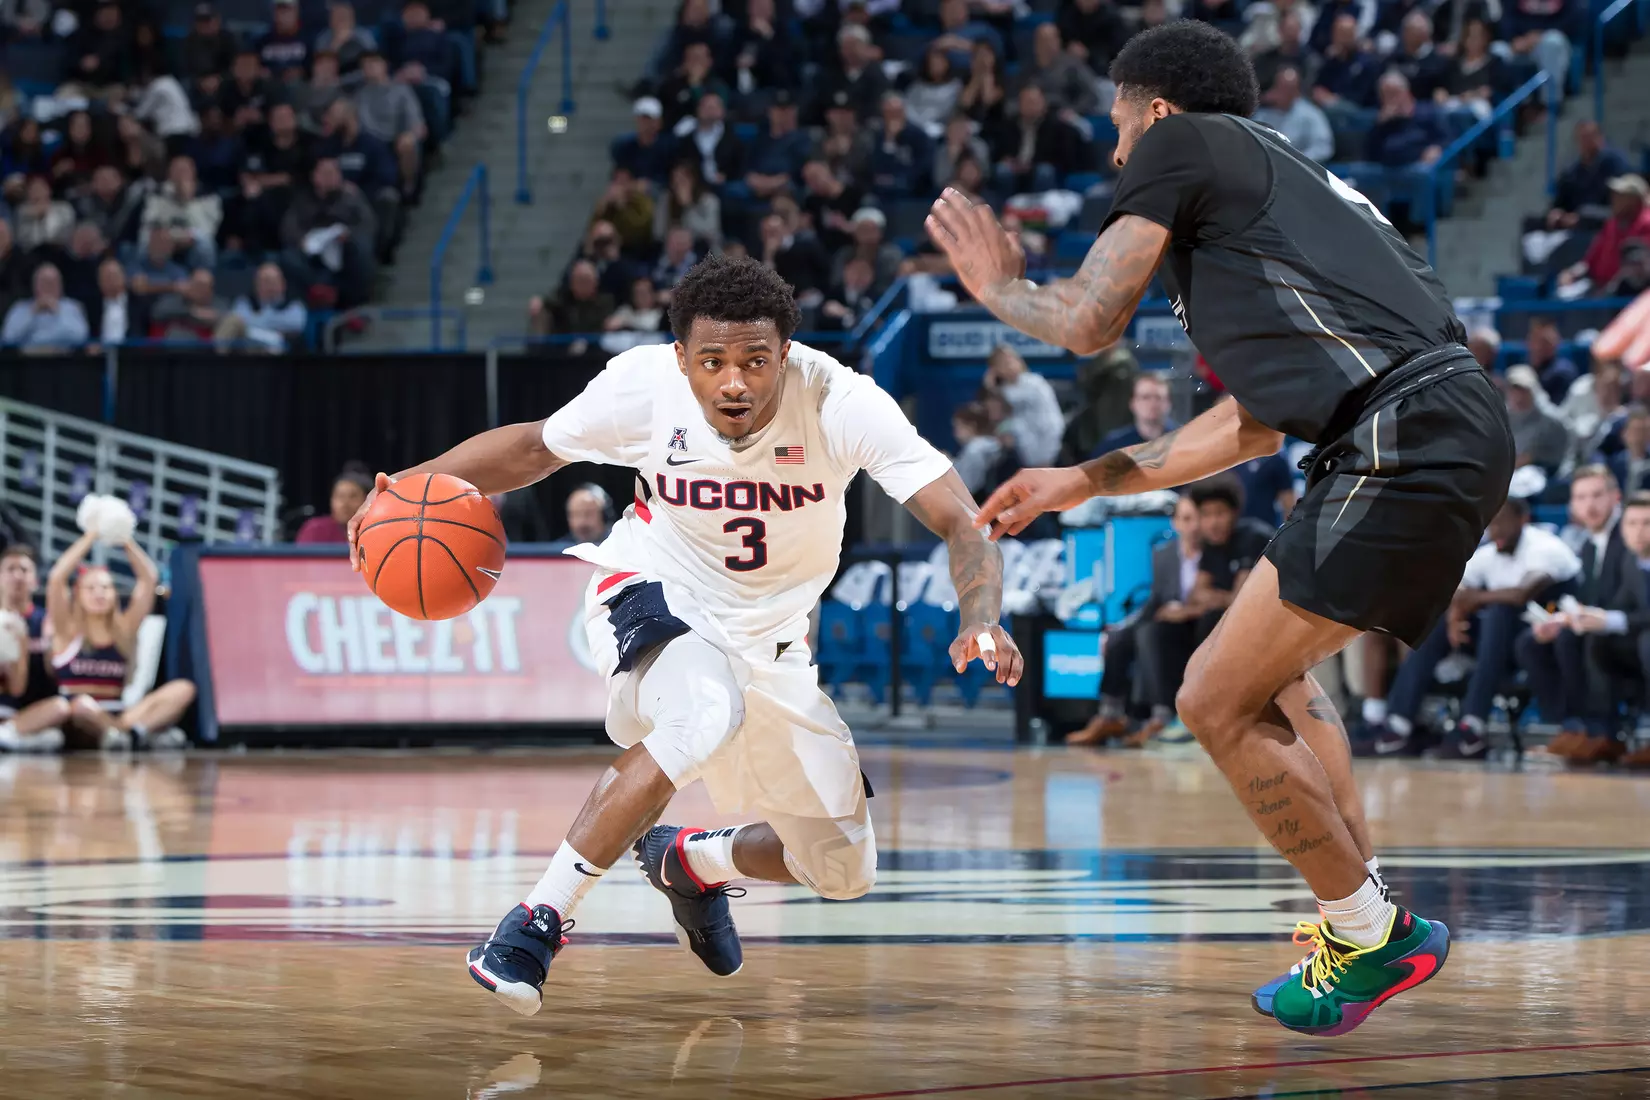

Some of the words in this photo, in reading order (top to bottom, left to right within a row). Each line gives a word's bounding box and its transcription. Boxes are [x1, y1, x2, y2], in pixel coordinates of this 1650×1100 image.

[656, 473, 825, 511] UCONN
[723, 516, 768, 572] 3
[1277, 831, 1333, 856] rothers
